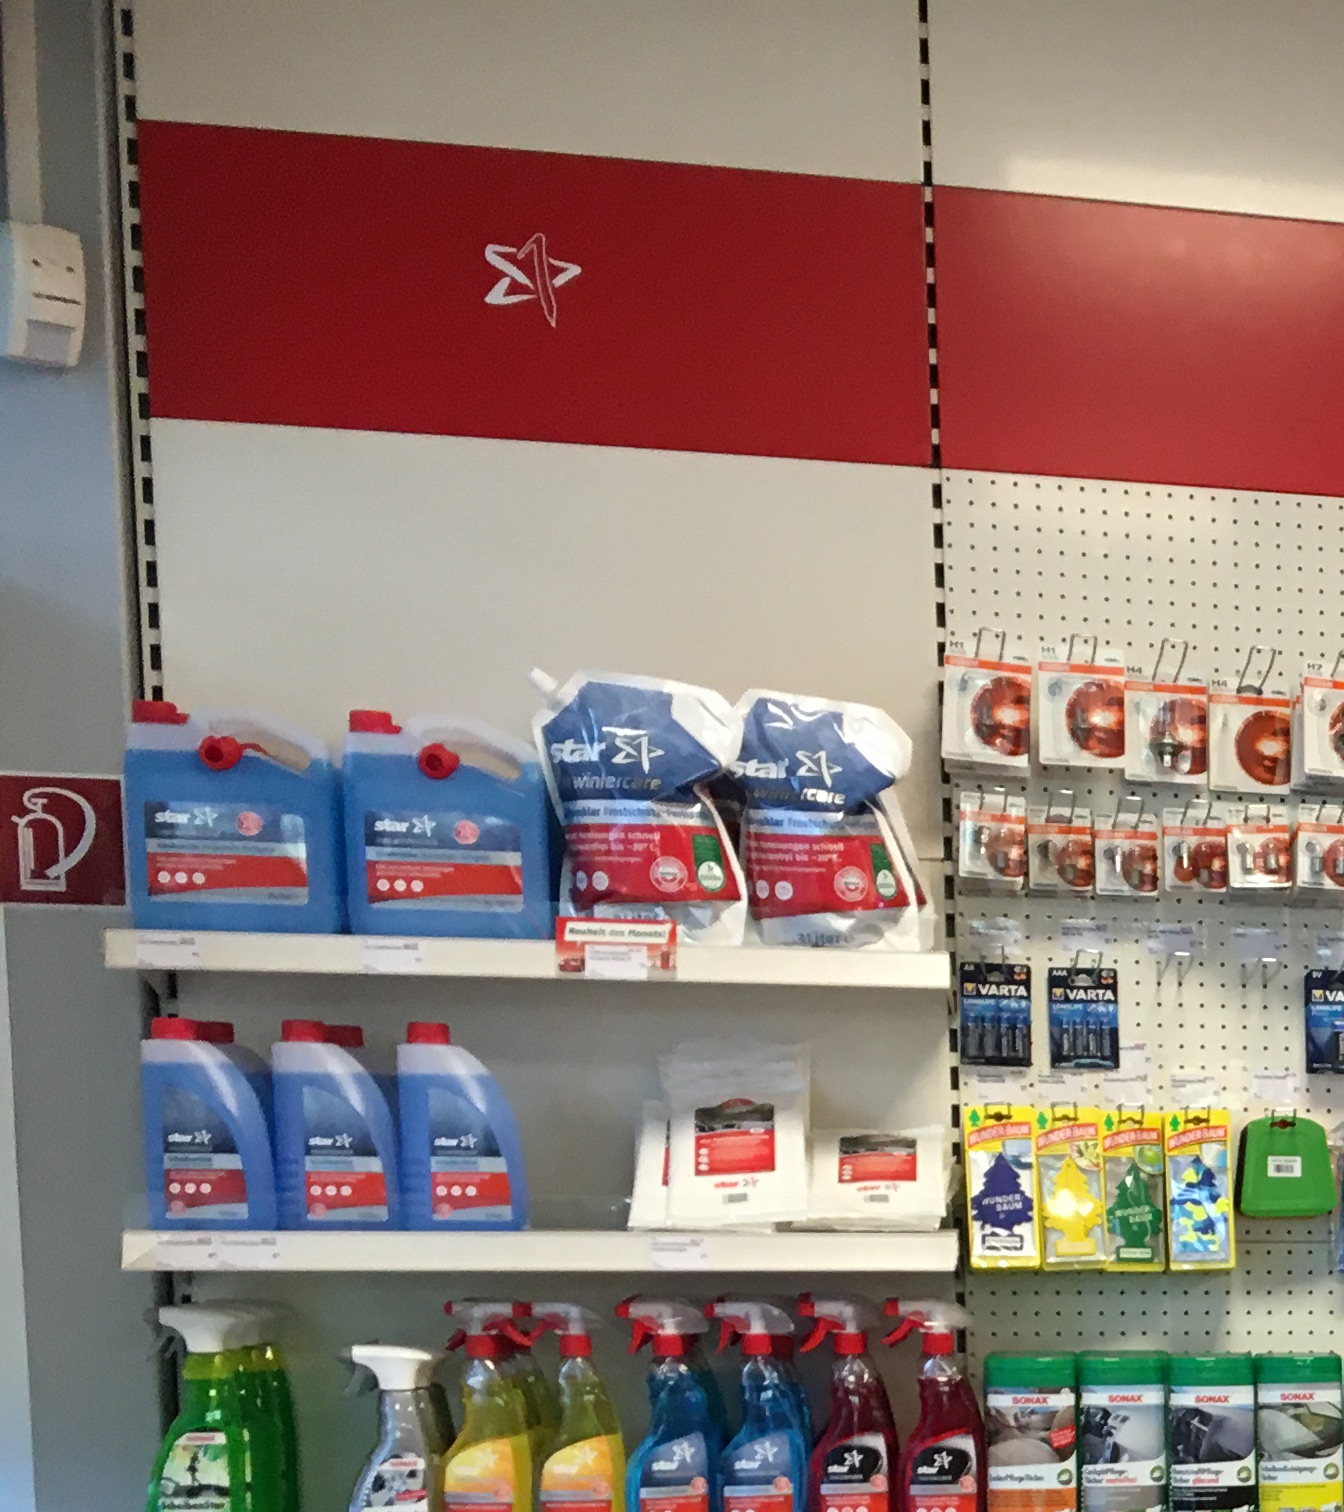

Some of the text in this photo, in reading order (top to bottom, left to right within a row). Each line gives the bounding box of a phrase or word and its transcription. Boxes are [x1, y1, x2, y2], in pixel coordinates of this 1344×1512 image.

[551, 738, 606, 764] star
[734, 758, 789, 781] star
[977, 983, 1028, 997] VARTA
[1066, 988, 1115, 1001] VARTA
[1012, 1396, 1049, 1405] SONAX
[1108, 1395, 1143, 1403] SONAX
[1194, 1395, 1229, 1404] SONAX
[1280, 1392, 1315, 1401] SONAX
